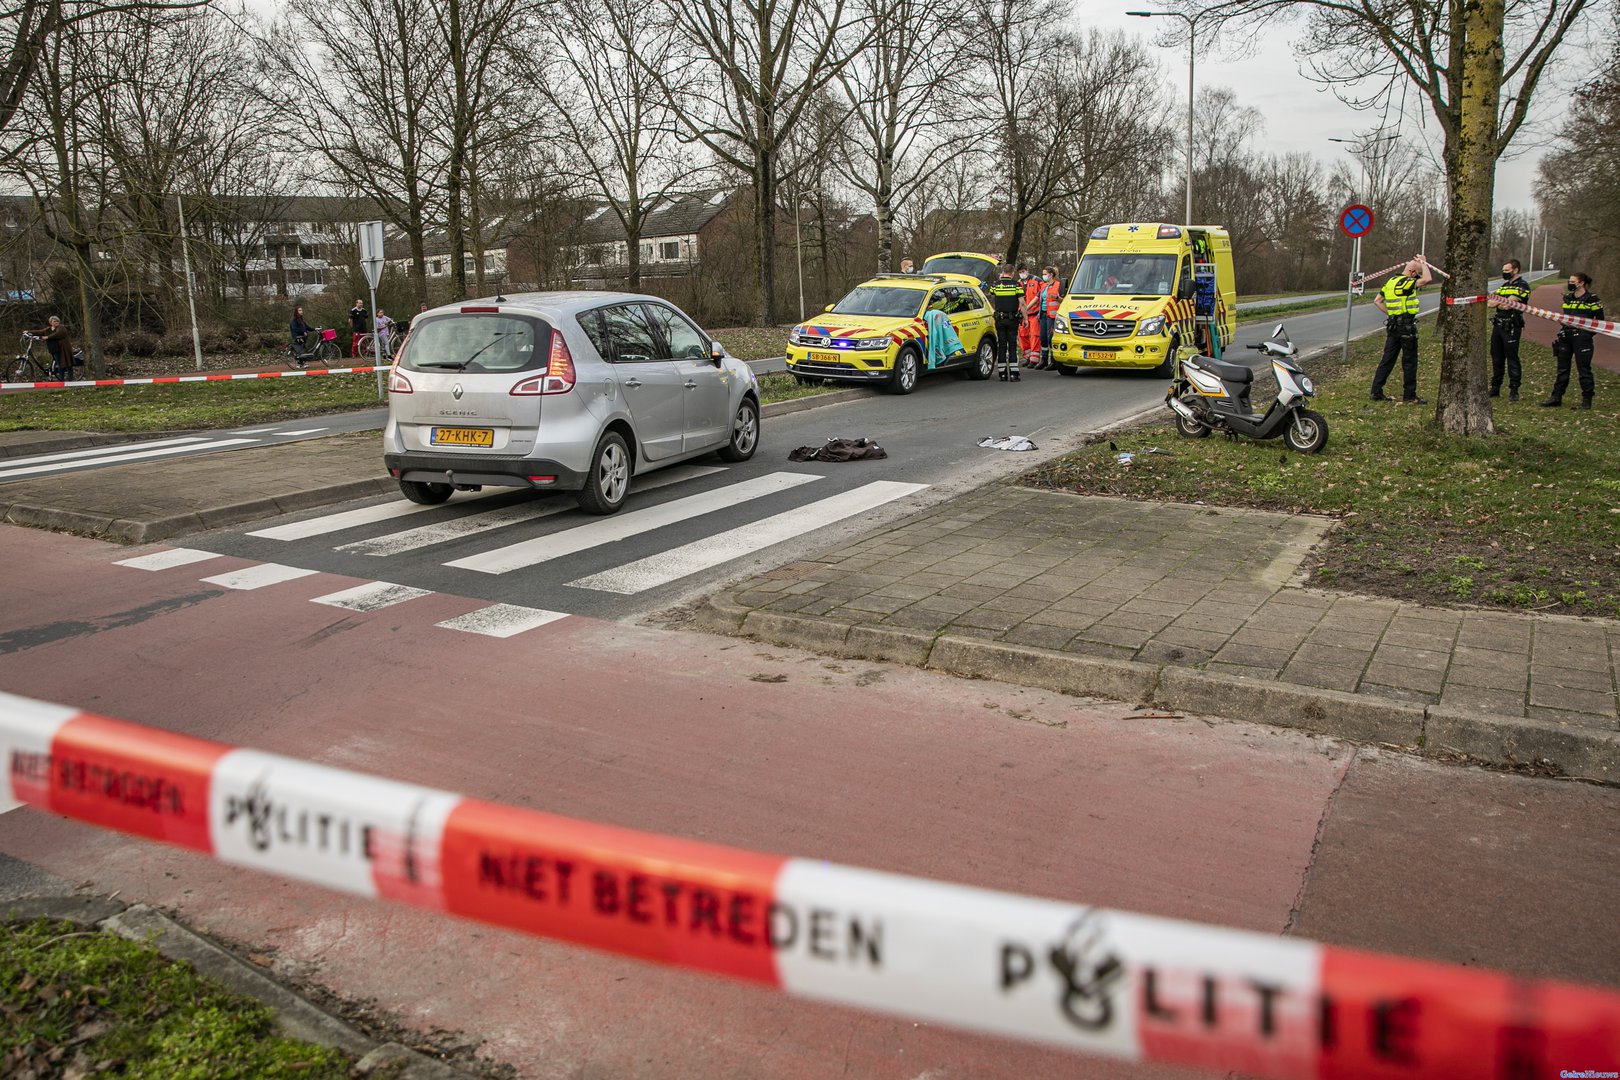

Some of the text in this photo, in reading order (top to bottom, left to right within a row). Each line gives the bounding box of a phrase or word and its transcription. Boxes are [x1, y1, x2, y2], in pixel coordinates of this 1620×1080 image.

[1075, 303, 1141, 311] AMBULANCE
[439, 430, 489, 442] 27-KHK-7
[10, 750, 186, 816] NIET BETREDEN
[479, 849, 886, 968] NIET BETREDEN
